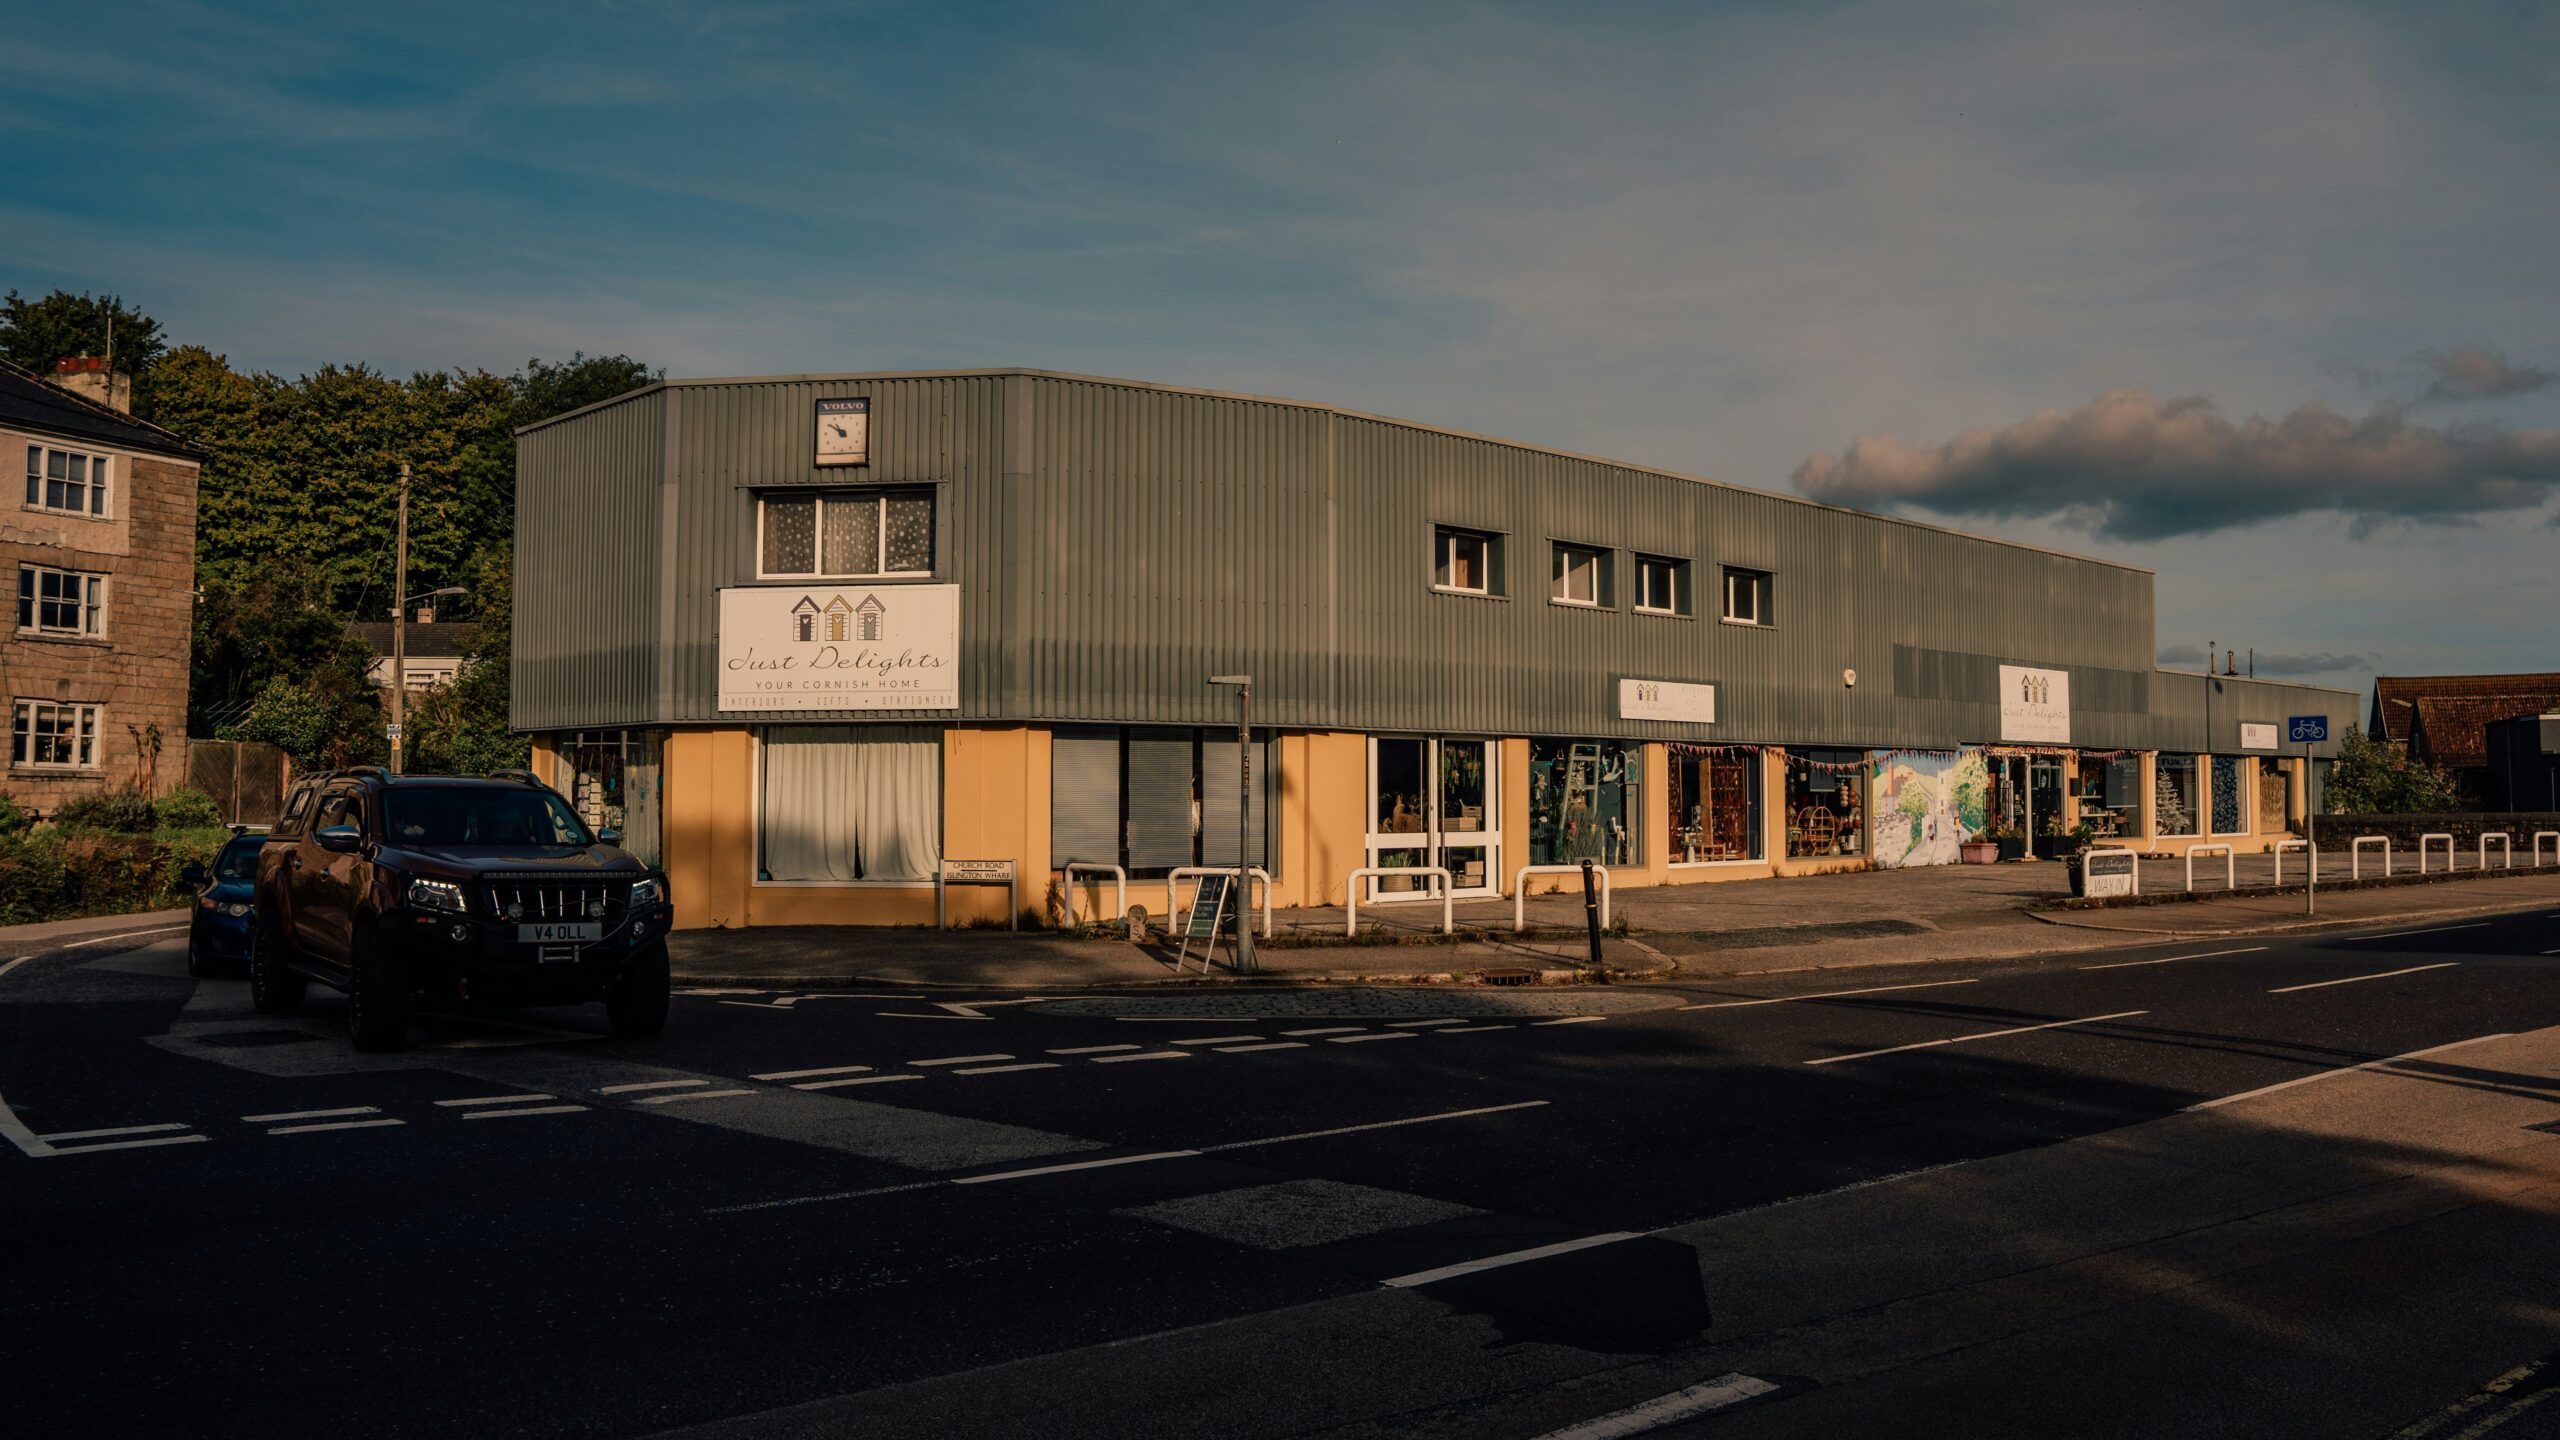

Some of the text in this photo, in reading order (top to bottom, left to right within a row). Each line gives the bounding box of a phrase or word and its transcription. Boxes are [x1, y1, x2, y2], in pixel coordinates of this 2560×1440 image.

[823, 402, 865, 410] VOLVO
[728, 646, 948, 677] Just Delights
[756, 679, 920, 690] YOUR CORNISH HOME
[725, 696, 952, 708] INTERIORS GIFTS STATIONERY
[2028, 704, 2066, 724] Delights
[2094, 878, 2124, 893] WAY IN
[535, 925, 586, 940] V4 OLL
